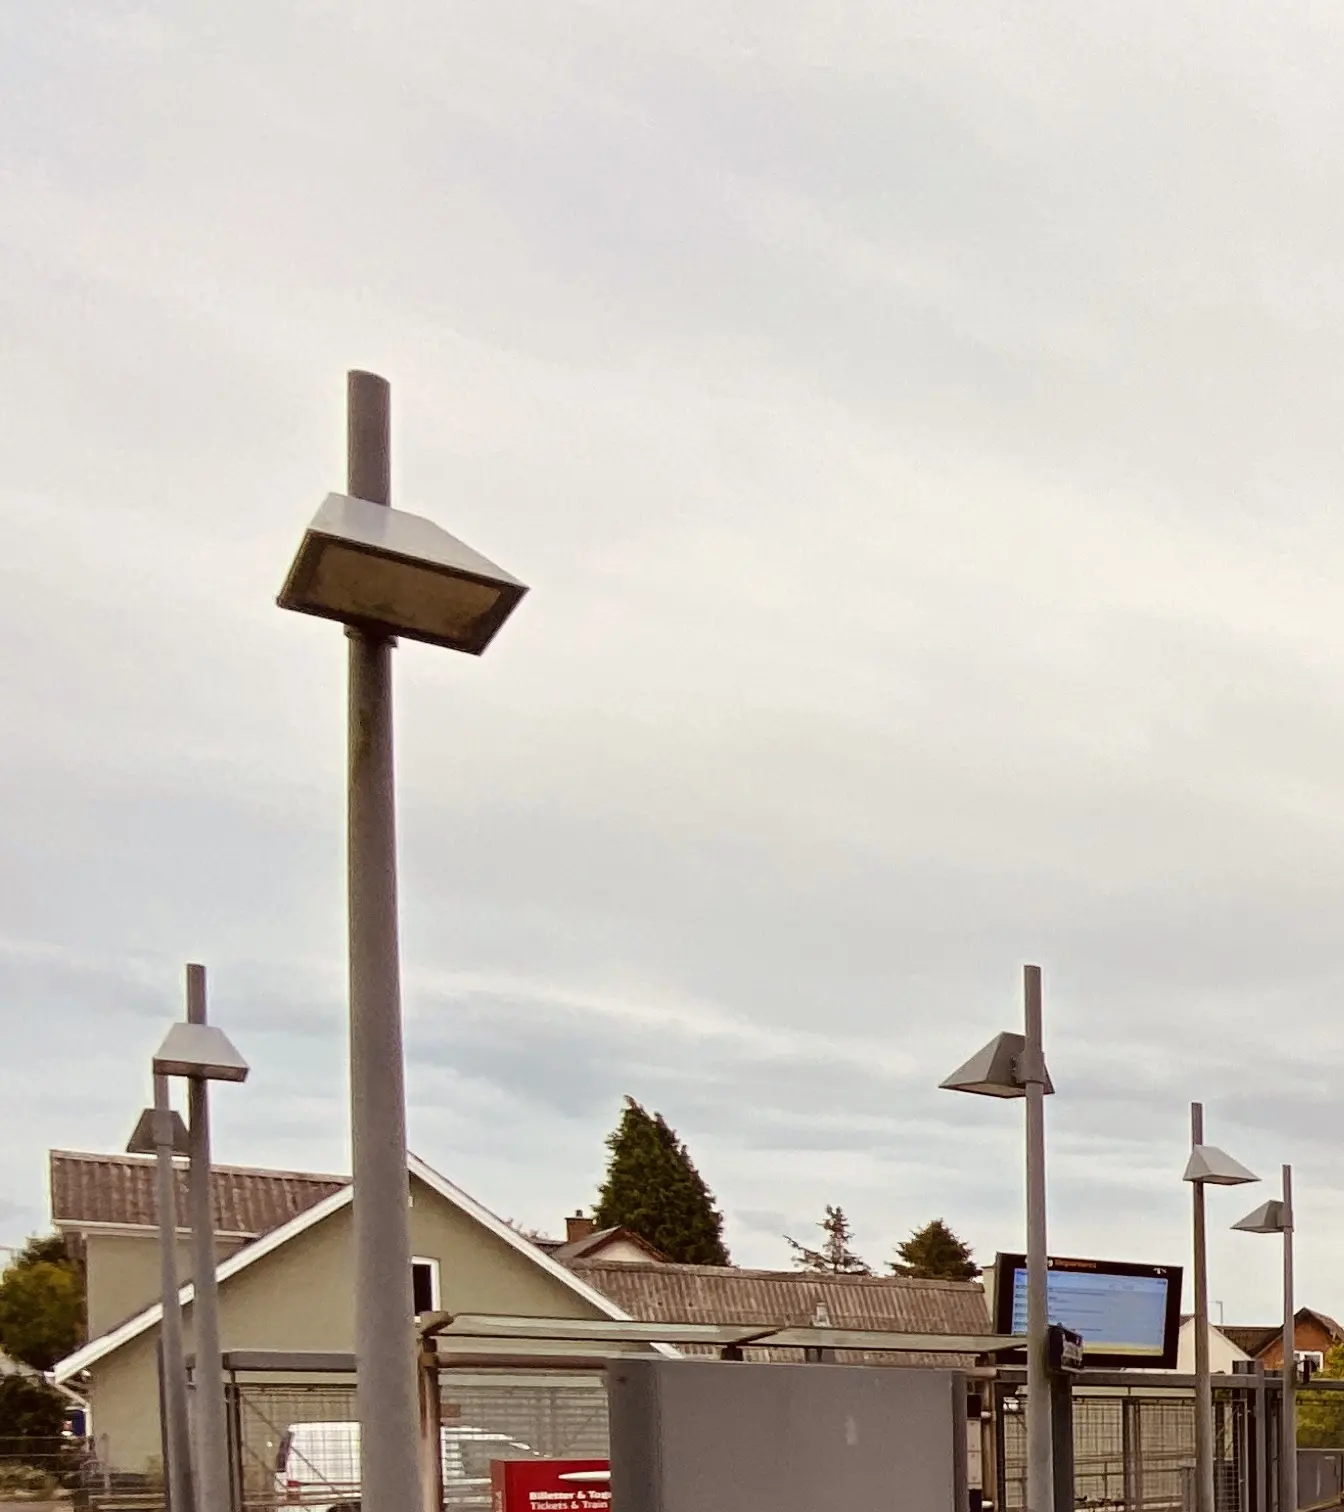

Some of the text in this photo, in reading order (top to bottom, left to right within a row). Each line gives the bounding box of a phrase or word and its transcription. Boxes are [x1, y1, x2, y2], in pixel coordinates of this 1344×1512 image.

[530, 1500, 608, 1510] Tickets & Train
